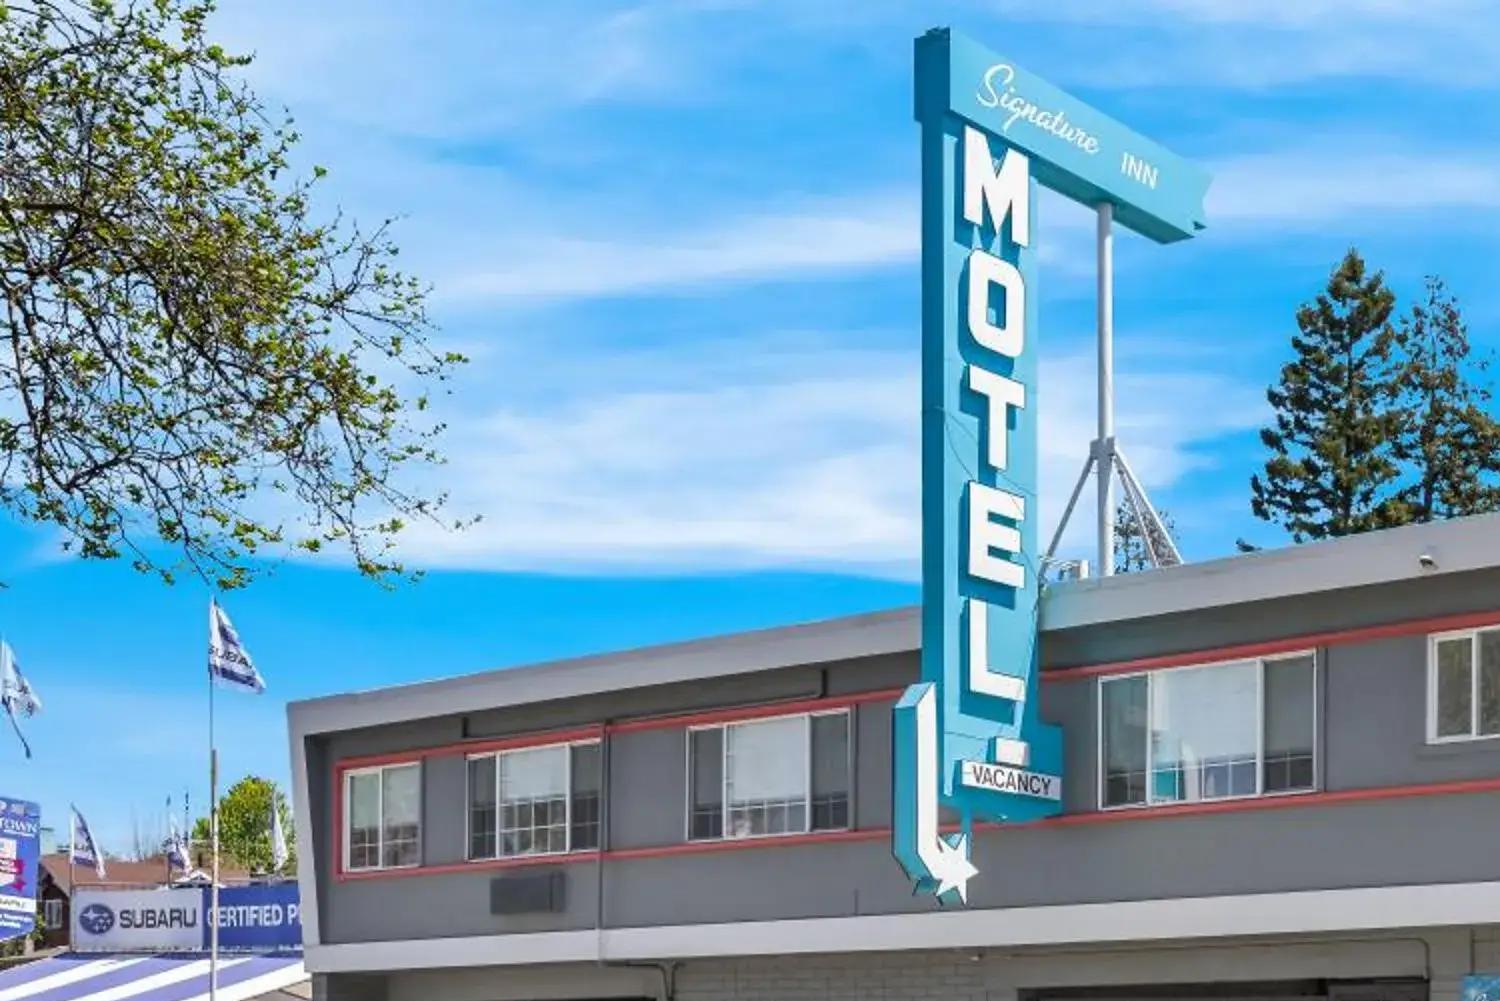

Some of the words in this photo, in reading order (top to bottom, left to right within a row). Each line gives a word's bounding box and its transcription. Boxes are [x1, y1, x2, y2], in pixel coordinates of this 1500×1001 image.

[976, 63, 1099, 154] Signature
[1121, 151, 1159, 190] INN
[964, 126, 1029, 701] MOTEL
[972, 764, 1052, 796] VACANCY
[119, 908, 197, 929] SUBARU
